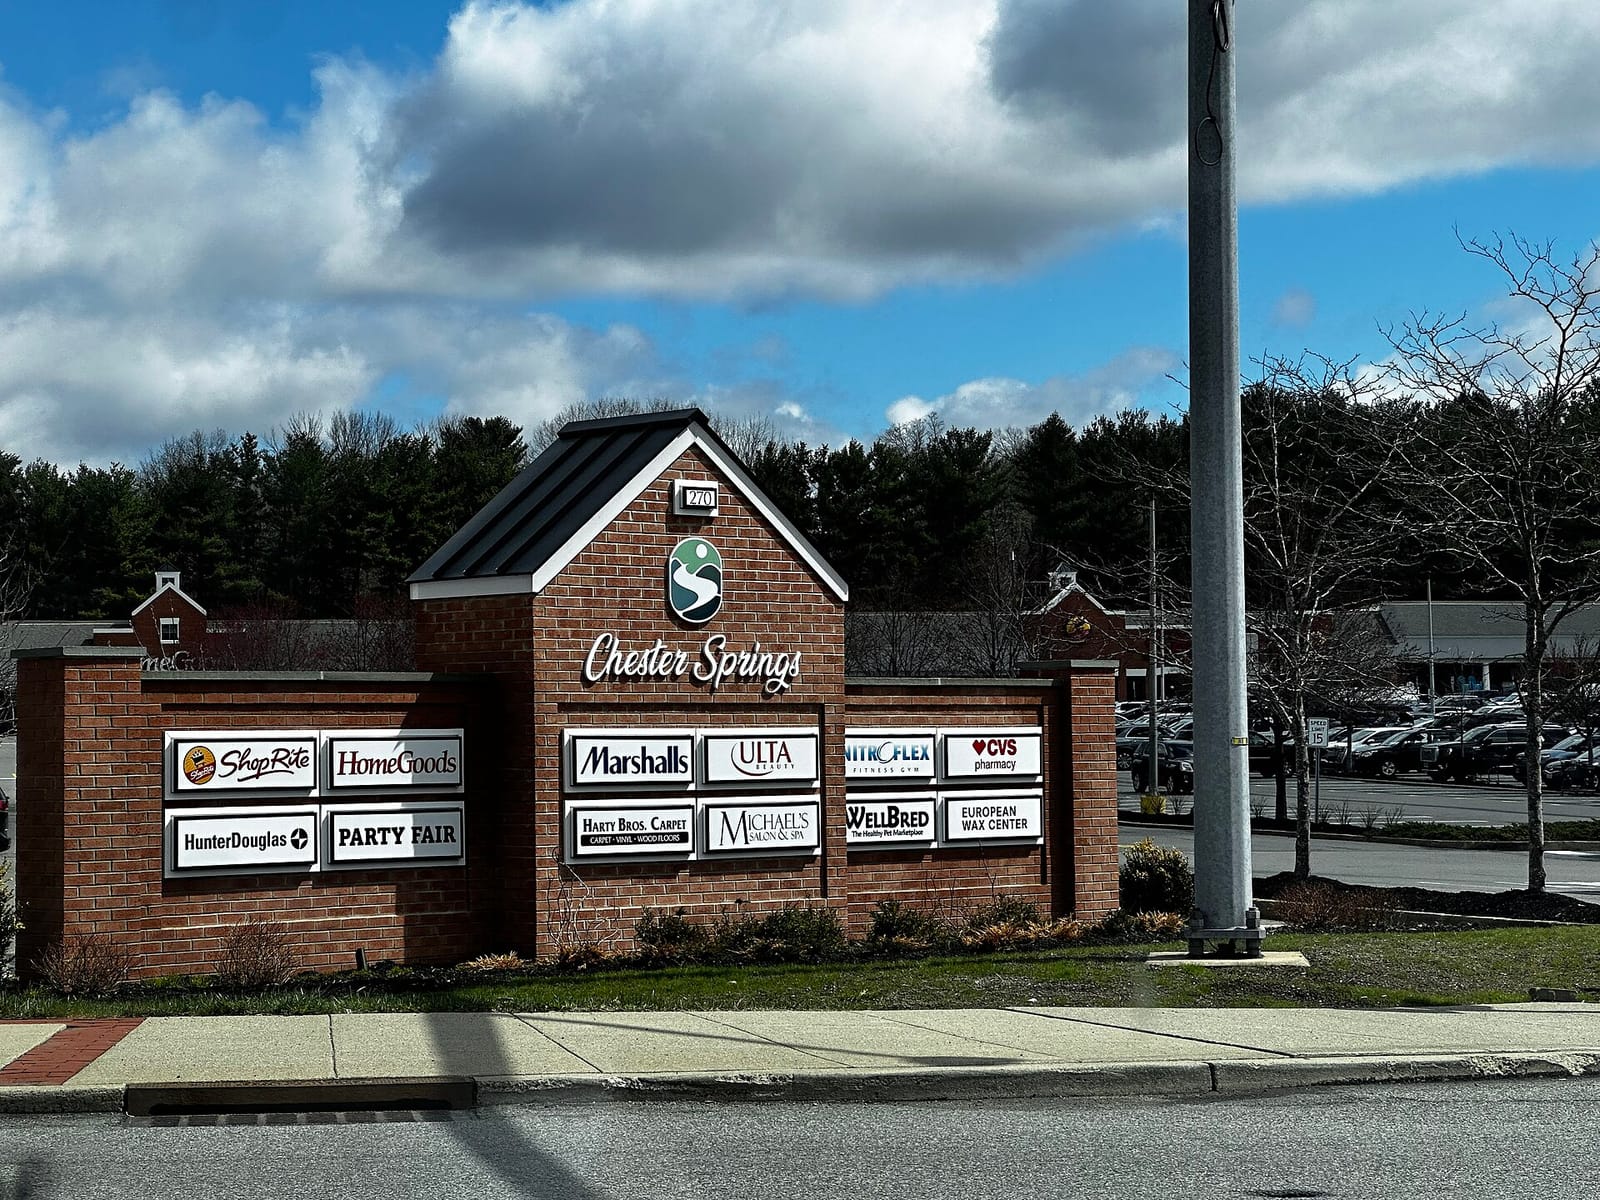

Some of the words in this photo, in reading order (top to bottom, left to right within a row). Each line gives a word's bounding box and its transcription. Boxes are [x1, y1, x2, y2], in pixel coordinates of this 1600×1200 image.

[689, 490, 712, 505] 270
[585, 632, 689, 682] Chester
[693, 634, 801, 693] Springs
[1313, 733, 1323, 744] 15
[739, 741, 792, 764] ULTA
[987, 739, 1017, 756] CVS
[218, 747, 309, 781] ShopRite
[337, 749, 457, 776] HomeGoods
[581, 745, 688, 775] Marshalls
[974, 759, 1016, 772] pharmacy
[962, 805, 1017, 818] EUROPEAN
[583, 818, 616, 832] HARTY
[618, 817, 647, 831] BROS.
[651, 816, 687, 831] CARPET
[720, 810, 809, 846] MICHAEL'S
[962, 819, 985, 831] WAX
[988, 818, 1028, 830] CENTER
[184, 830, 287, 852] HunterDouglas
[339, 827, 404, 847] PARTY
[411, 825, 457, 845] FAIR
[589, 836, 612, 844] CARPET
[616, 835, 633, 843] VINYL
[637, 835, 657, 843] WOOD
[658, 834, 680, 842] FLOORS
[749, 830, 777, 842] SALON
[777, 828, 789, 841] &
[790, 830, 804, 841] SPA
[851, 830, 862, 838] The
[863, 830, 883, 838] Healthy
[884, 829, 892, 837] Pet
[893, 829, 924, 837] Marketplace
